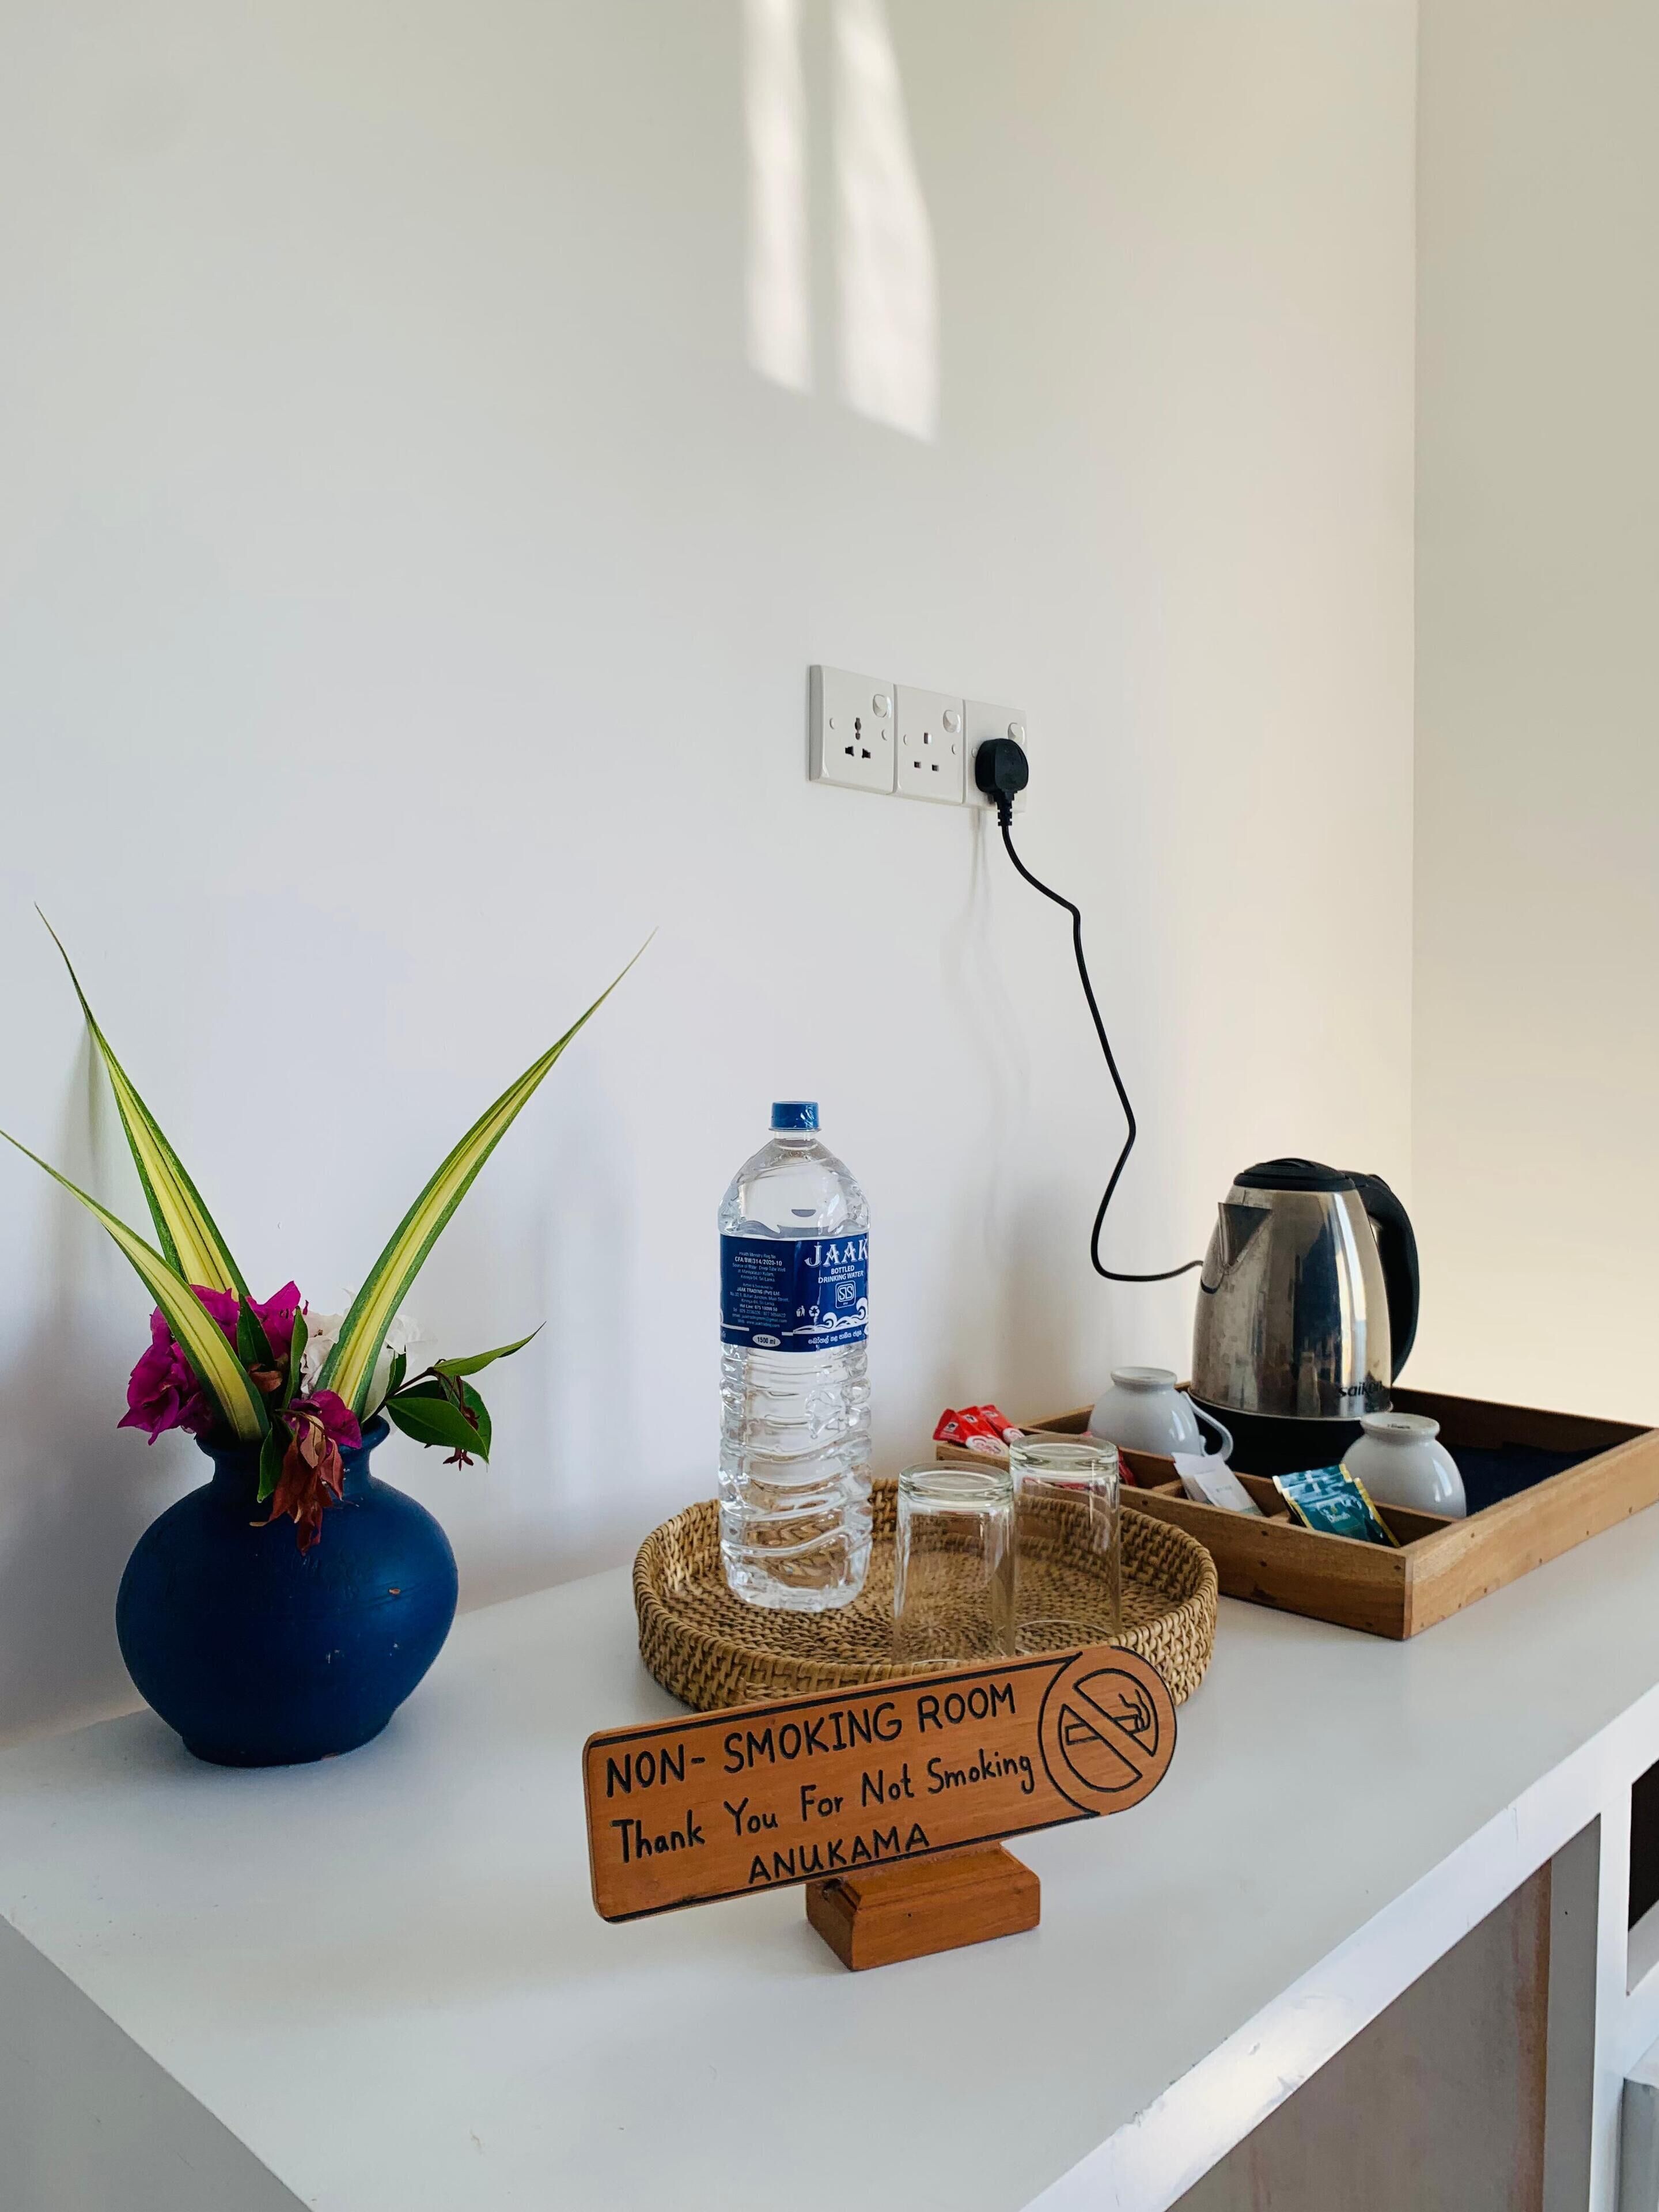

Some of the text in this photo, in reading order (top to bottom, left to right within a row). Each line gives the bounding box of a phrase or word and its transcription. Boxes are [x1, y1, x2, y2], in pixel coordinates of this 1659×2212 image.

[804, 1238, 868, 1267] JAAK
[831, 1265, 855, 1275] BOTTLED
[818, 1270, 864, 1283] DRINKING WATER
[722, 1701, 904, 1775] SMOKING
[916, 1682, 1017, 1734] ROOM
[612, 1747, 1036, 1864] Thank You For Not Smoking
[747, 1822, 931, 1885] ANUKAMA
